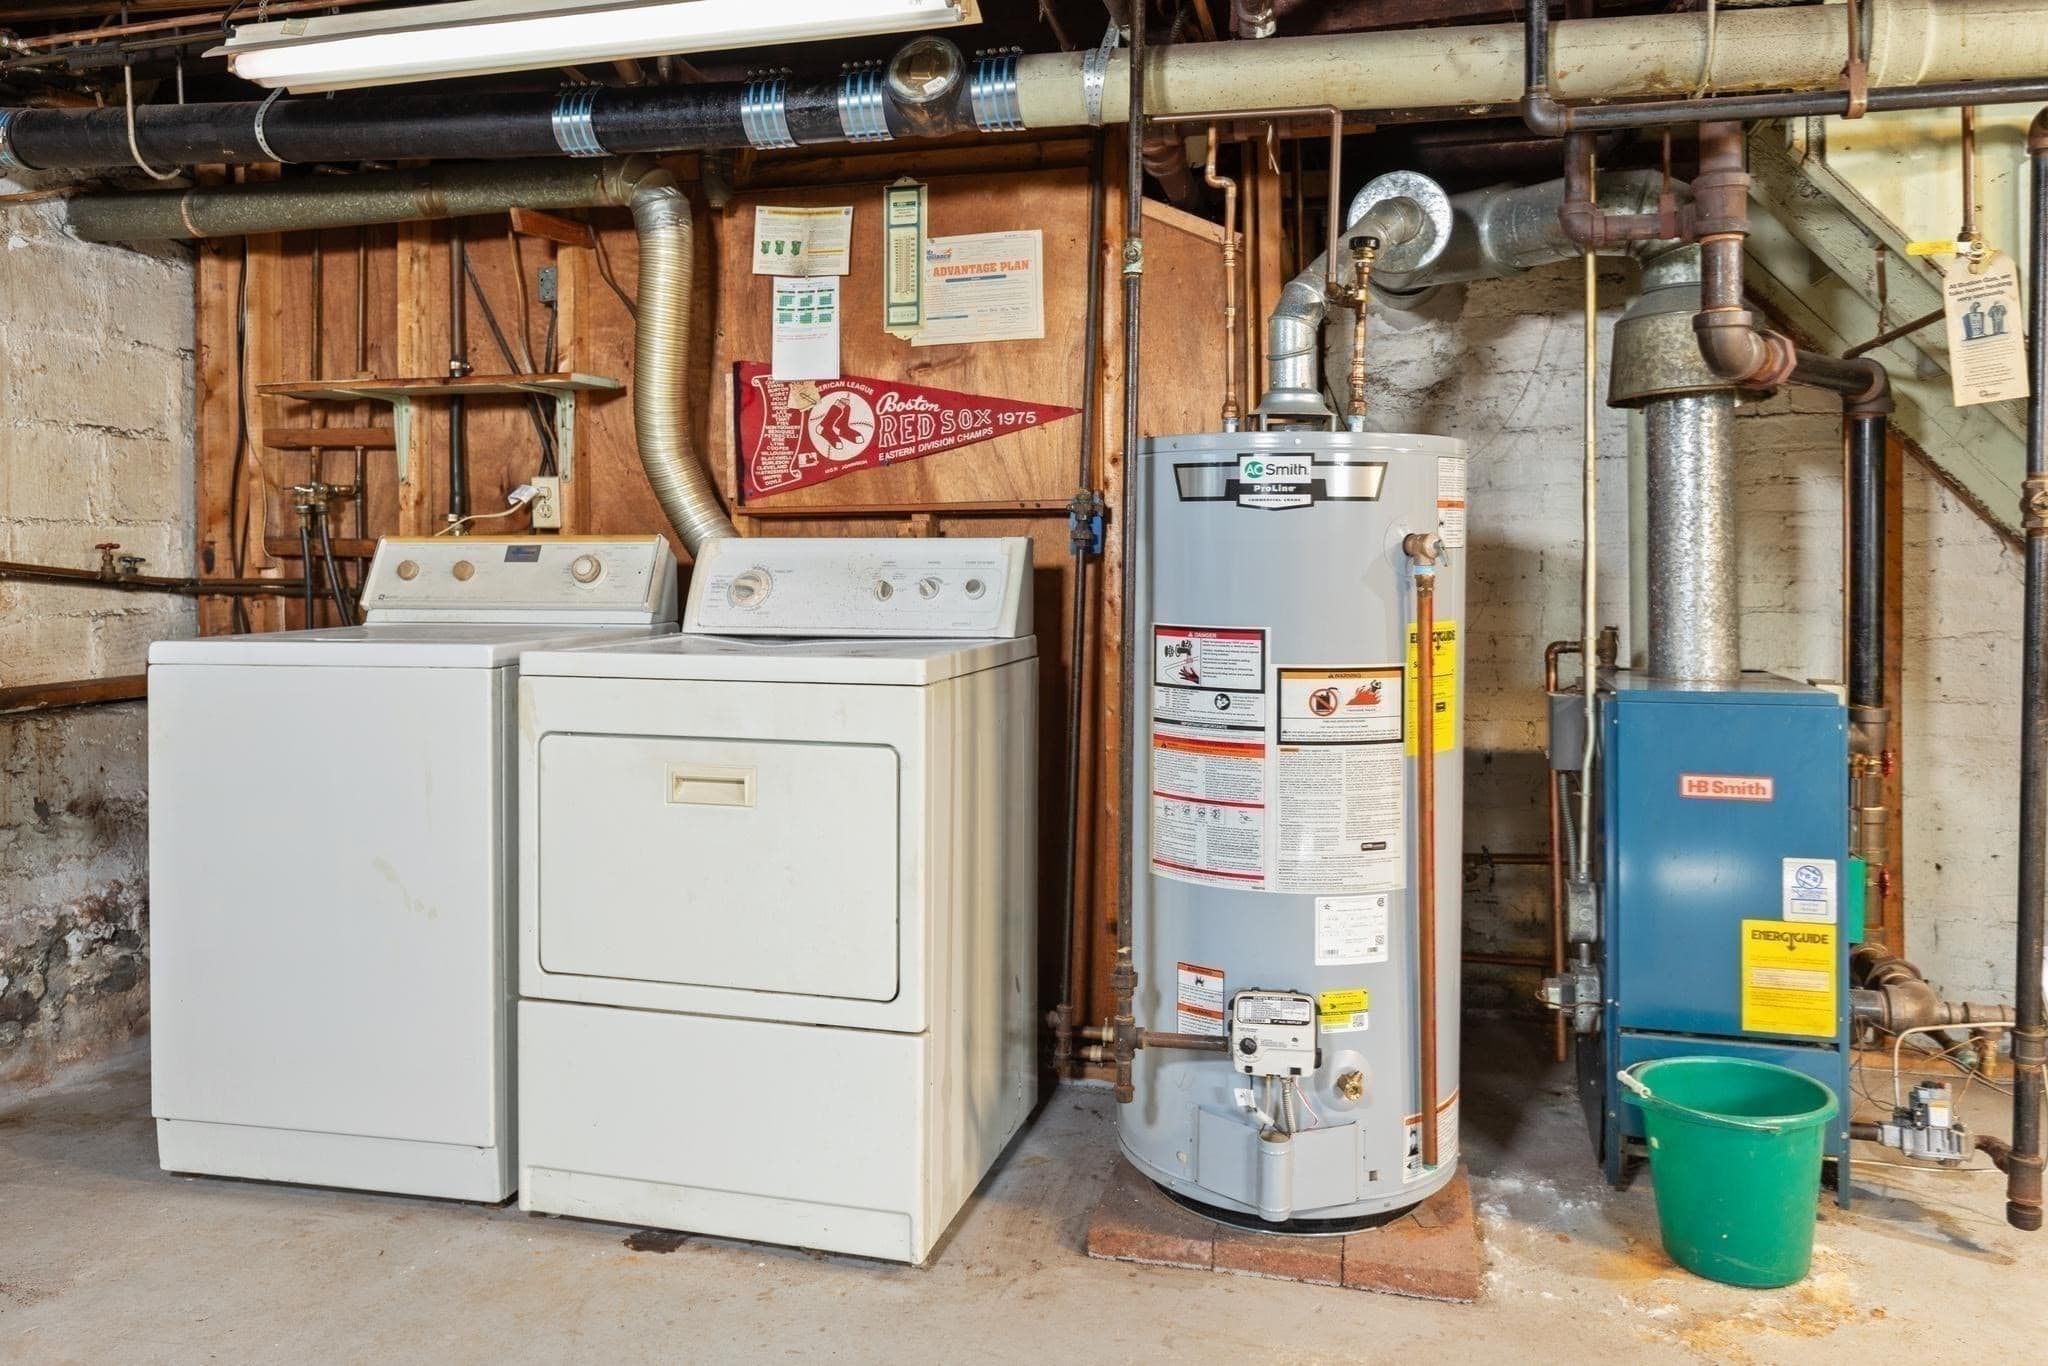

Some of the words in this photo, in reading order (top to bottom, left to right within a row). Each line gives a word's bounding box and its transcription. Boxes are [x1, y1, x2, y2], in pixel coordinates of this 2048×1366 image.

[933, 263, 997, 277] ADVANTAGE
[1000, 260, 1030, 272] PLAN
[846, 381, 874, 396] LEAGUE
[876, 391, 941, 415] Boston
[997, 411, 1037, 426] 1975
[878, 413, 936, 448] RED
[940, 408, 992, 435] SOX
[878, 447, 915, 461] EASTERN
[918, 435, 955, 453] DIVISION
[956, 427, 994, 443] CHAMPS
[1266, 463, 1307, 476] Smith
[1254, 484, 1295, 493] ProLine
[1687, 780, 1709, 793] HB
[1711, 780, 1766, 796] Smith
